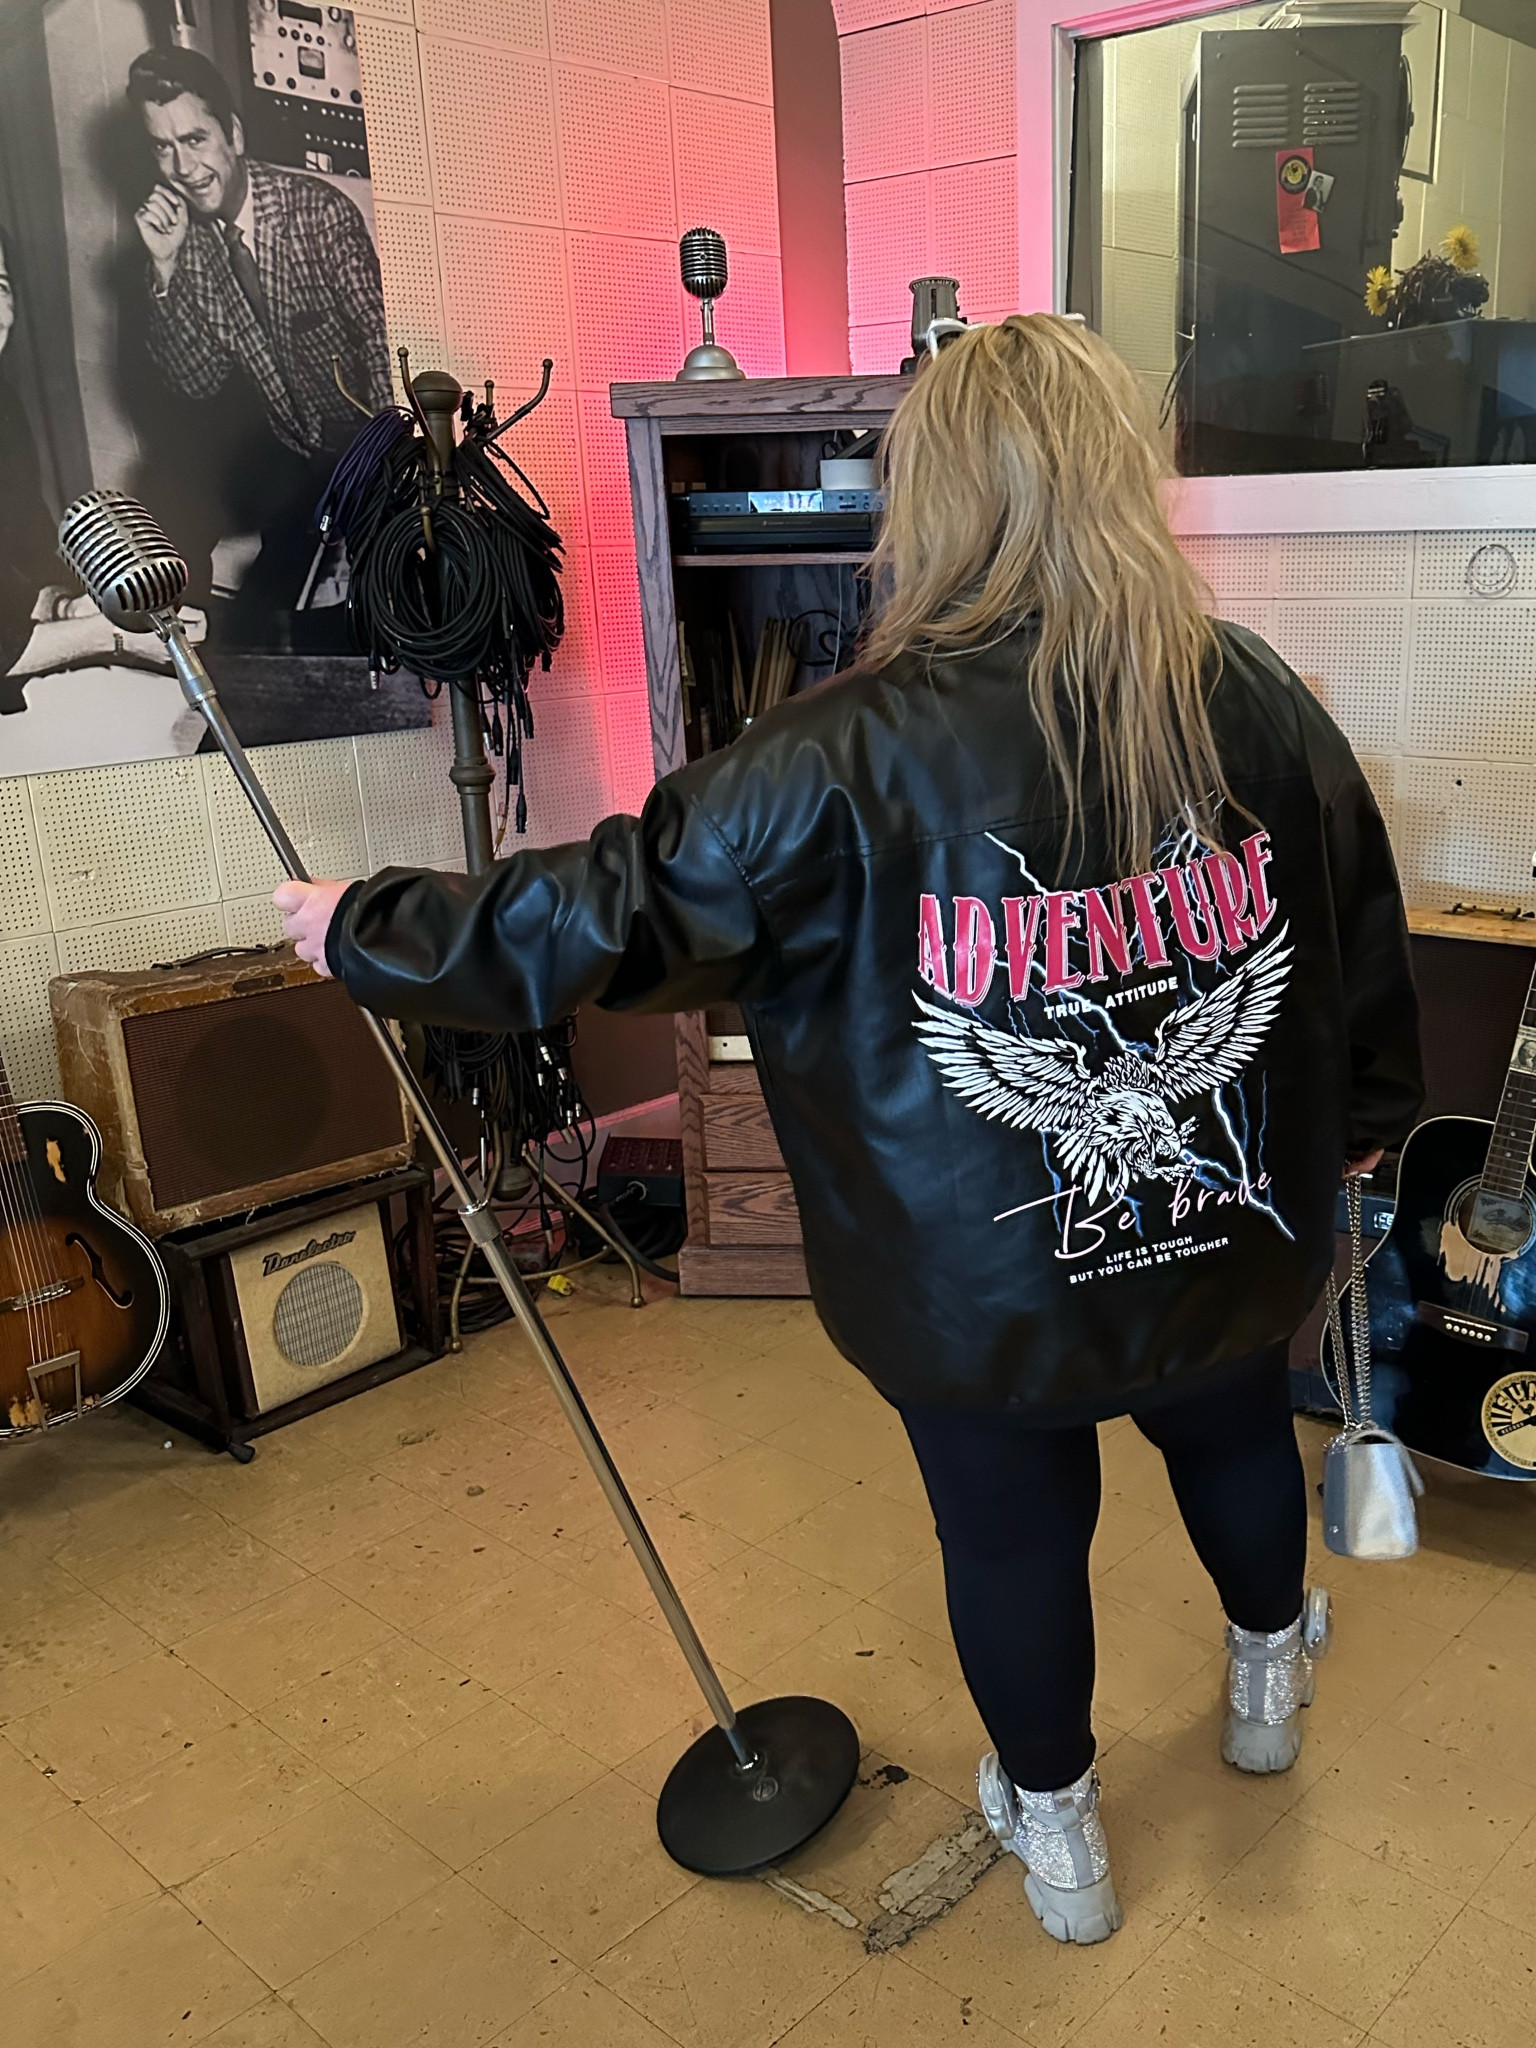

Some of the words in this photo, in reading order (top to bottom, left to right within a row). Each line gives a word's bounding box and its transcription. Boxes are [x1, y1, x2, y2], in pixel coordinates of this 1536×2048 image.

[918, 831, 1278, 1008] ADVENTURE
[1043, 998, 1092, 1020] TRUE
[1104, 976, 1179, 1009] ATTITUDE
[993, 1183, 1137, 1260] Be
[262, 1230, 357, 1277] Danelectro
[1069, 1270, 1094, 1285] BUT
[1098, 1263, 1123, 1278] YOU
[1127, 1256, 1152, 1270] CAN
[1156, 1252, 1172, 1264] BE
[1175, 1237, 1229, 1259] TOUGHER
[1106, 1250, 1132, 1264] LIFE
[1136, 1246, 1149, 1257] IS
[1152, 1235, 1194, 1253] TOUGH
